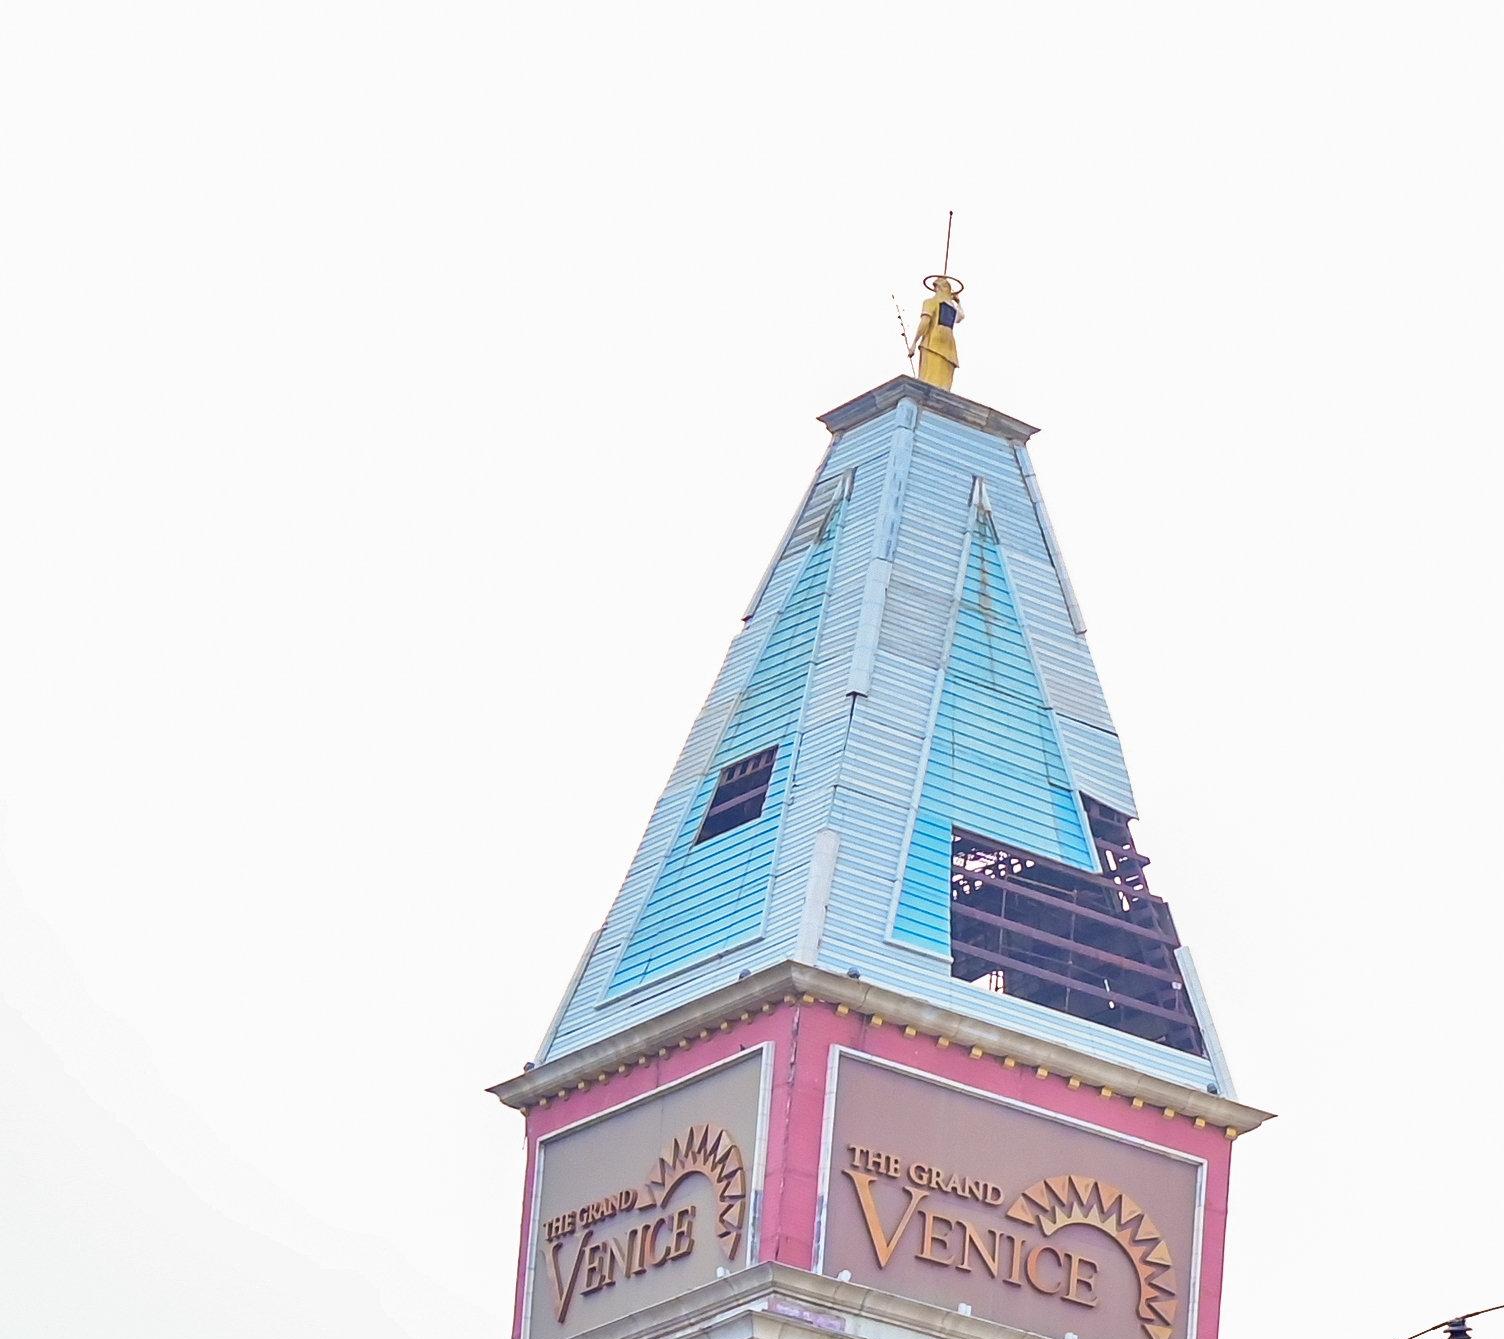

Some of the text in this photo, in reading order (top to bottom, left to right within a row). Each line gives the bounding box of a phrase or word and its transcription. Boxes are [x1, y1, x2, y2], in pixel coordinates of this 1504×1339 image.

[542, 1188, 639, 1243] THE GRAND
[847, 1143, 1005, 1206] THE GRAND
[540, 1205, 697, 1324] VENICE
[841, 1168, 1099, 1308] VENICE
